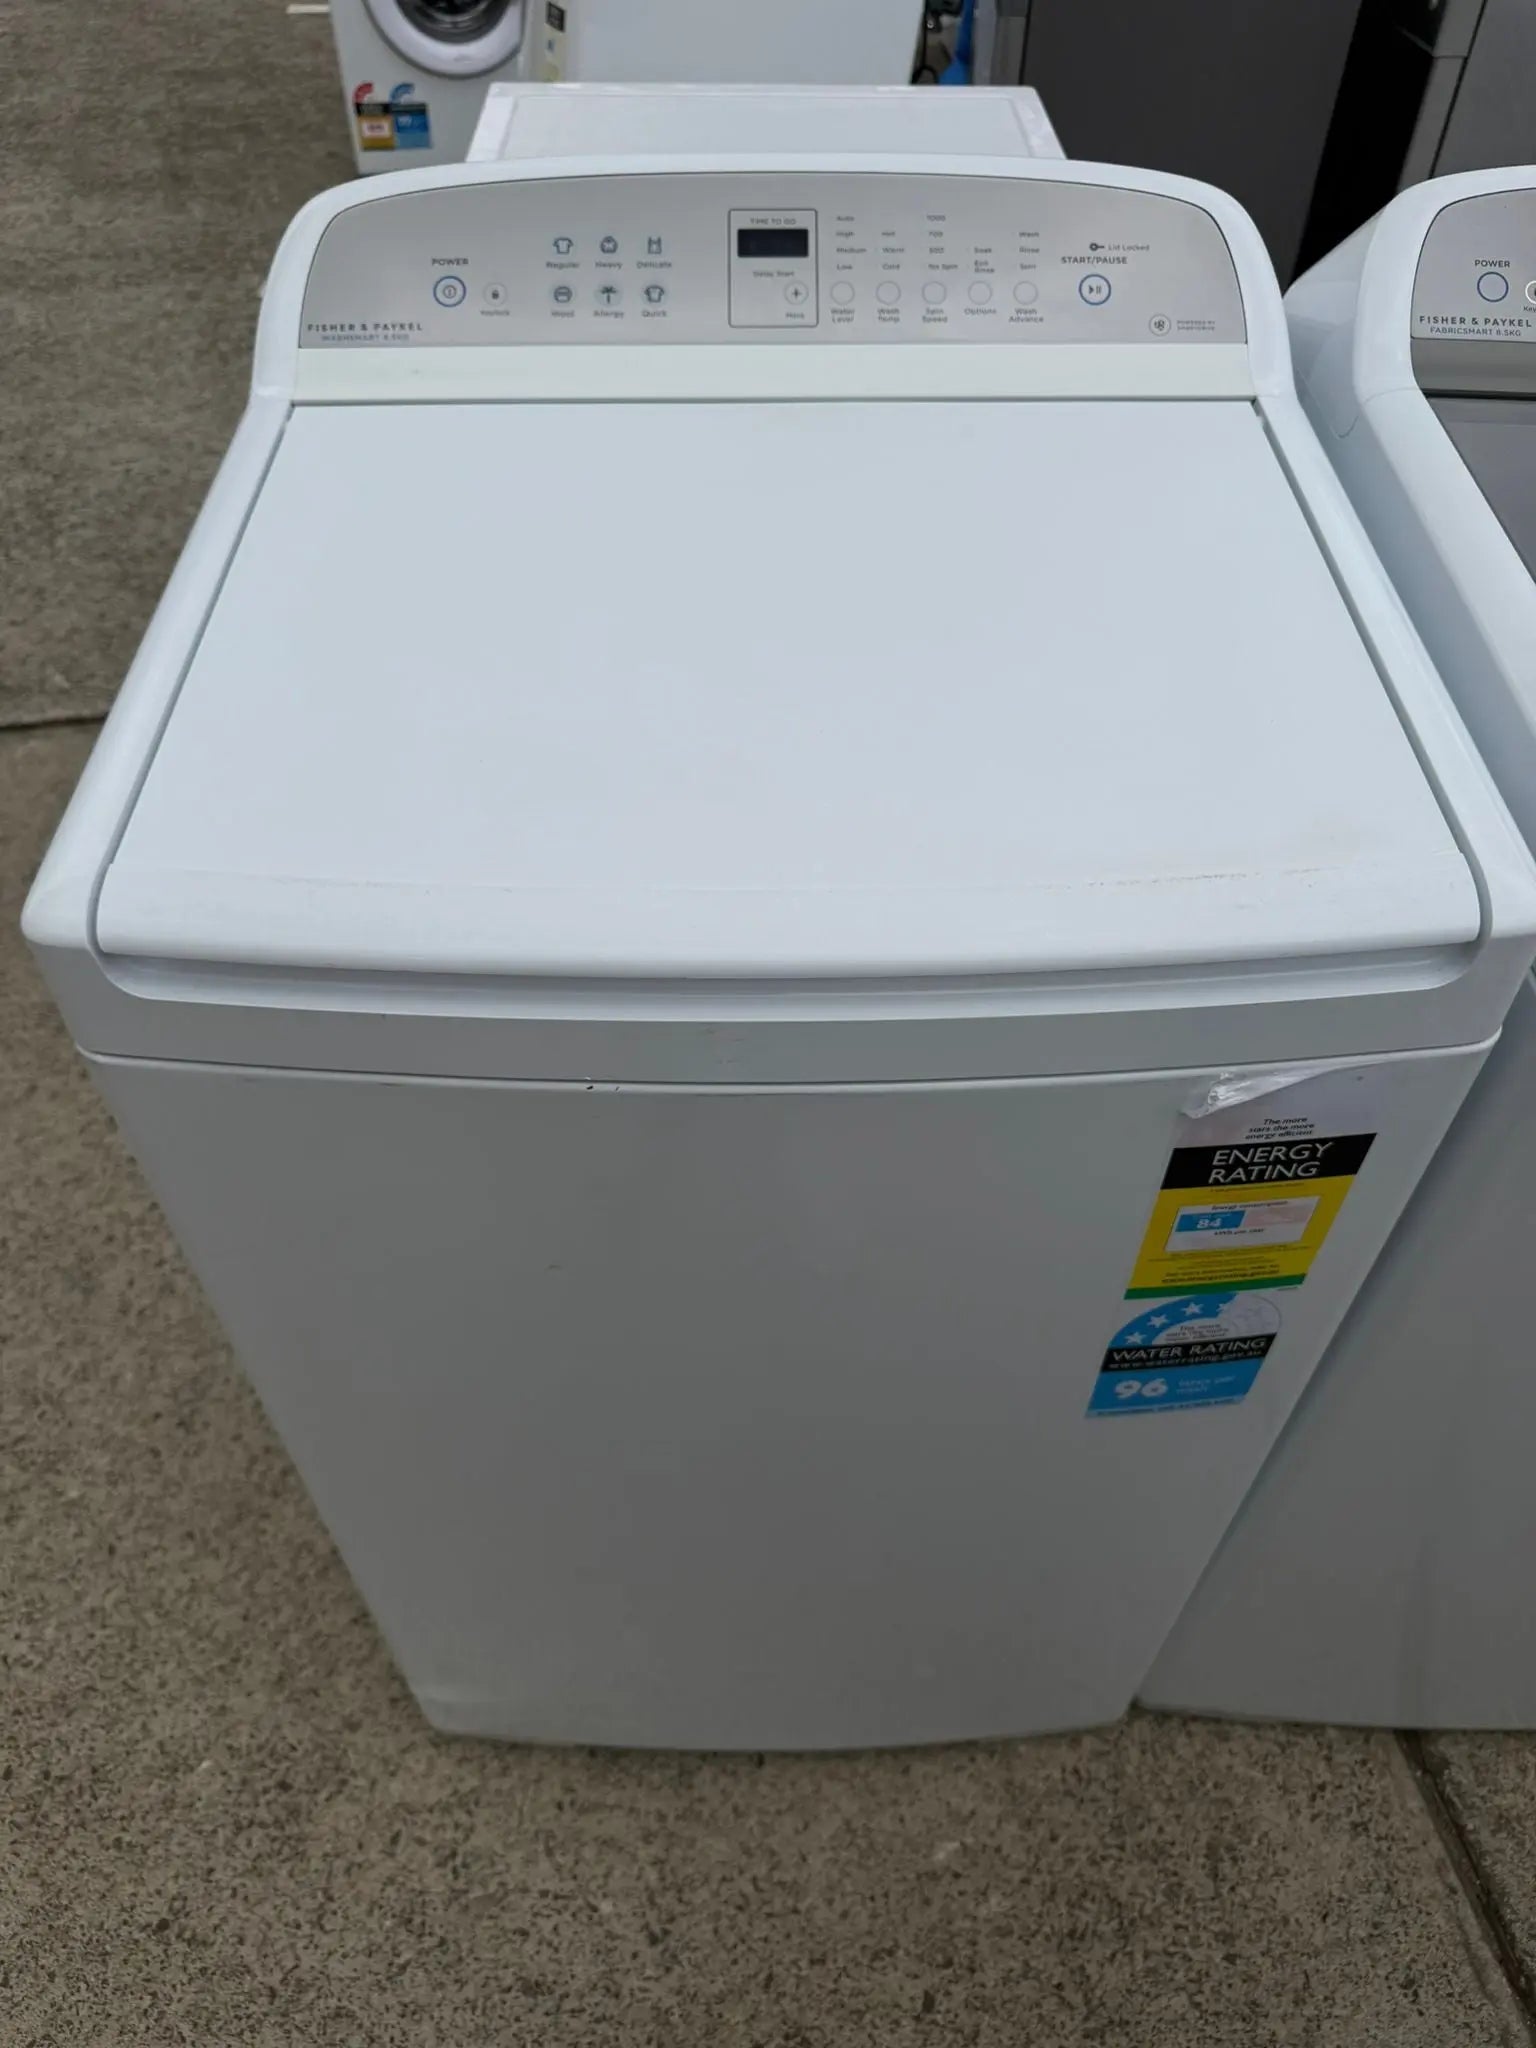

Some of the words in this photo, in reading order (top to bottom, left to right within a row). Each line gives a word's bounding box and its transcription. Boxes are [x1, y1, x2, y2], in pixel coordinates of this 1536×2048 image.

[432, 258, 469, 266] POWER
[1061, 256, 1128, 264] START/PAUSE
[1474, 260, 1510, 268] POWER
[636, 261, 672, 269] Delicate
[642, 310, 667, 318] Quick
[1419, 316, 1466, 325] FISHER
[1472, 316, 1479, 325] &
[1484, 318, 1532, 328] PAYKEL
[307, 324, 356, 332] FISHER
[374, 322, 422, 332] PAYKEL
[1430, 327, 1493, 336] FABRICSMART
[1278, 1130, 1312, 1138] efficient
[1212, 1142, 1334, 1166] ENERGY
[1208, 1161, 1321, 1184] RATING
[1196, 1218, 1223, 1229] 84
[1113, 1347, 1184, 1362] WATER
[1190, 1338, 1266, 1355] RATING
[1114, 1378, 1169, 1399] 96
